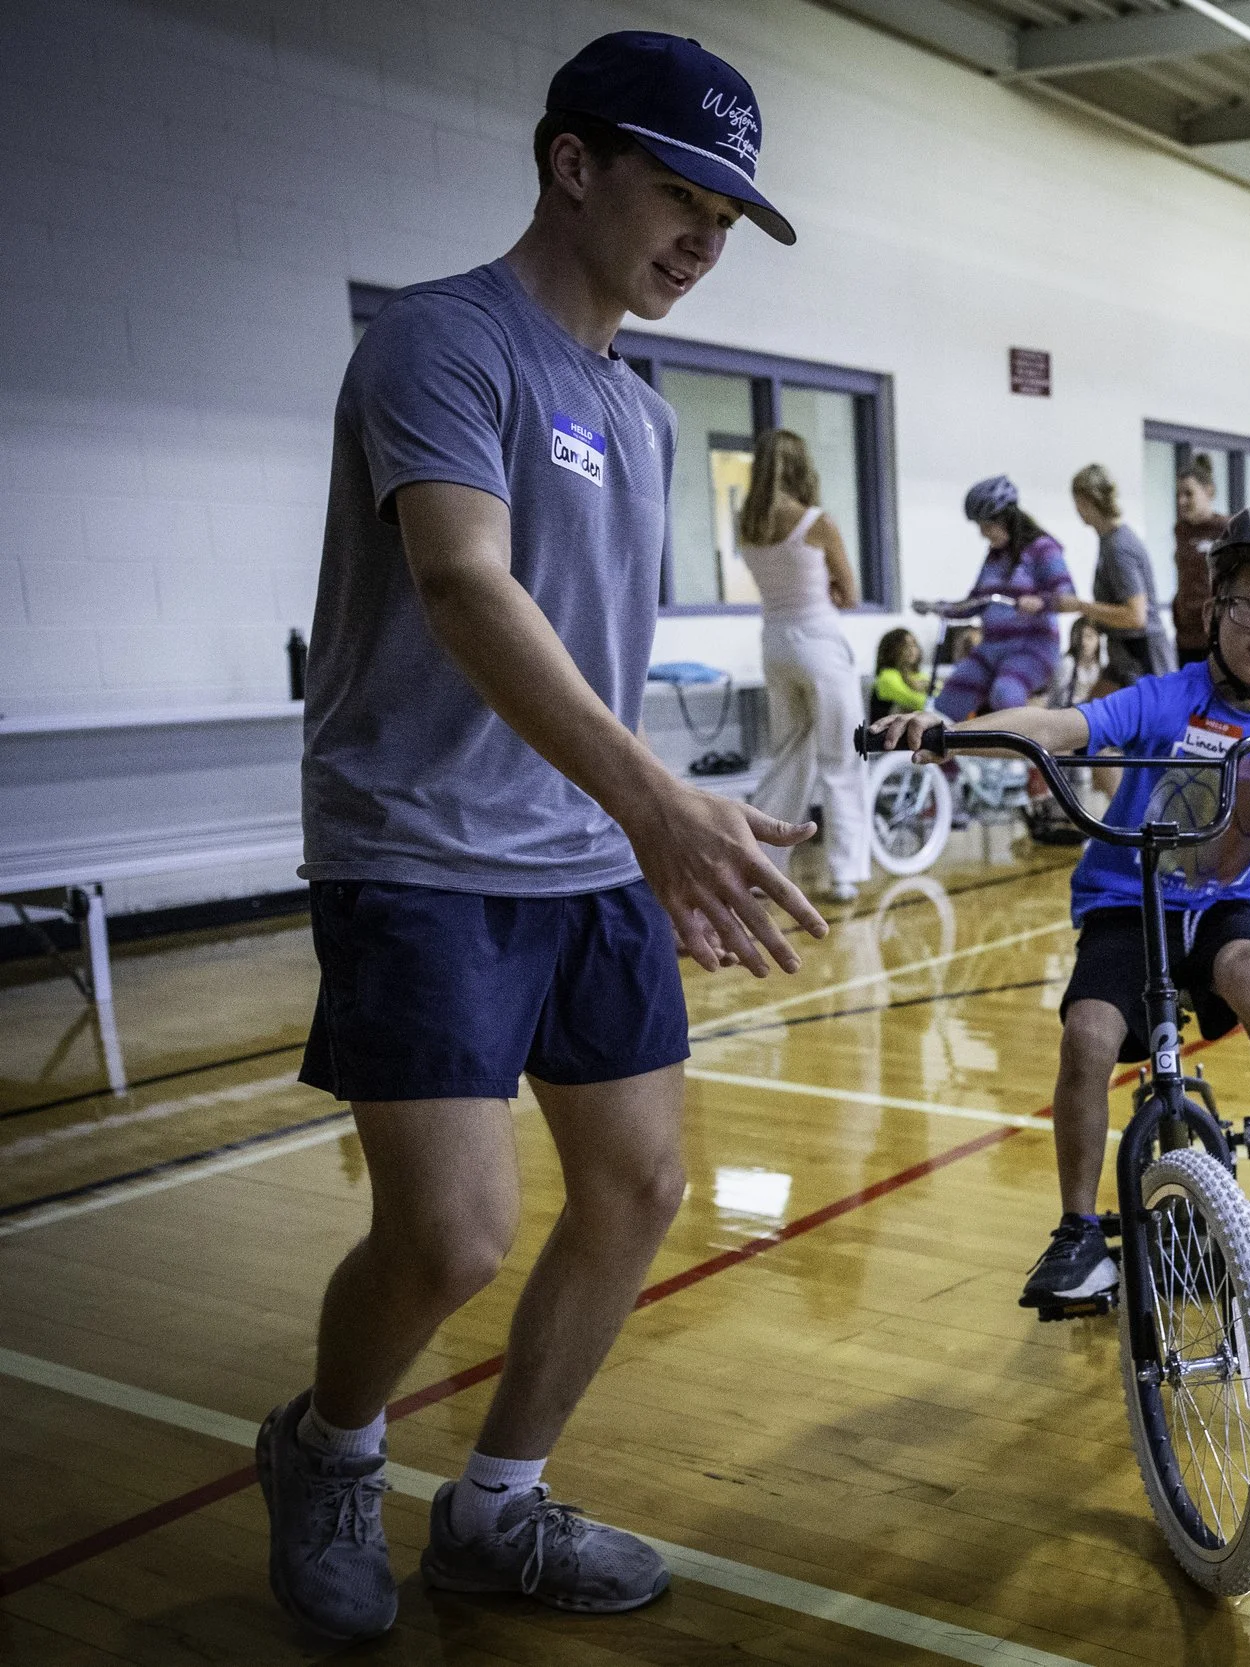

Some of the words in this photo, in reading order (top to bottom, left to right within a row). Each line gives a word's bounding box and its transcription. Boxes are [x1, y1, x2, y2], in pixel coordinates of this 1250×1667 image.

[702, 88, 758, 132] Western
[570, 422, 593, 440] HELLO
[553, 435, 601, 481] Camden
[1159, 1053, 1172, 1069] C
